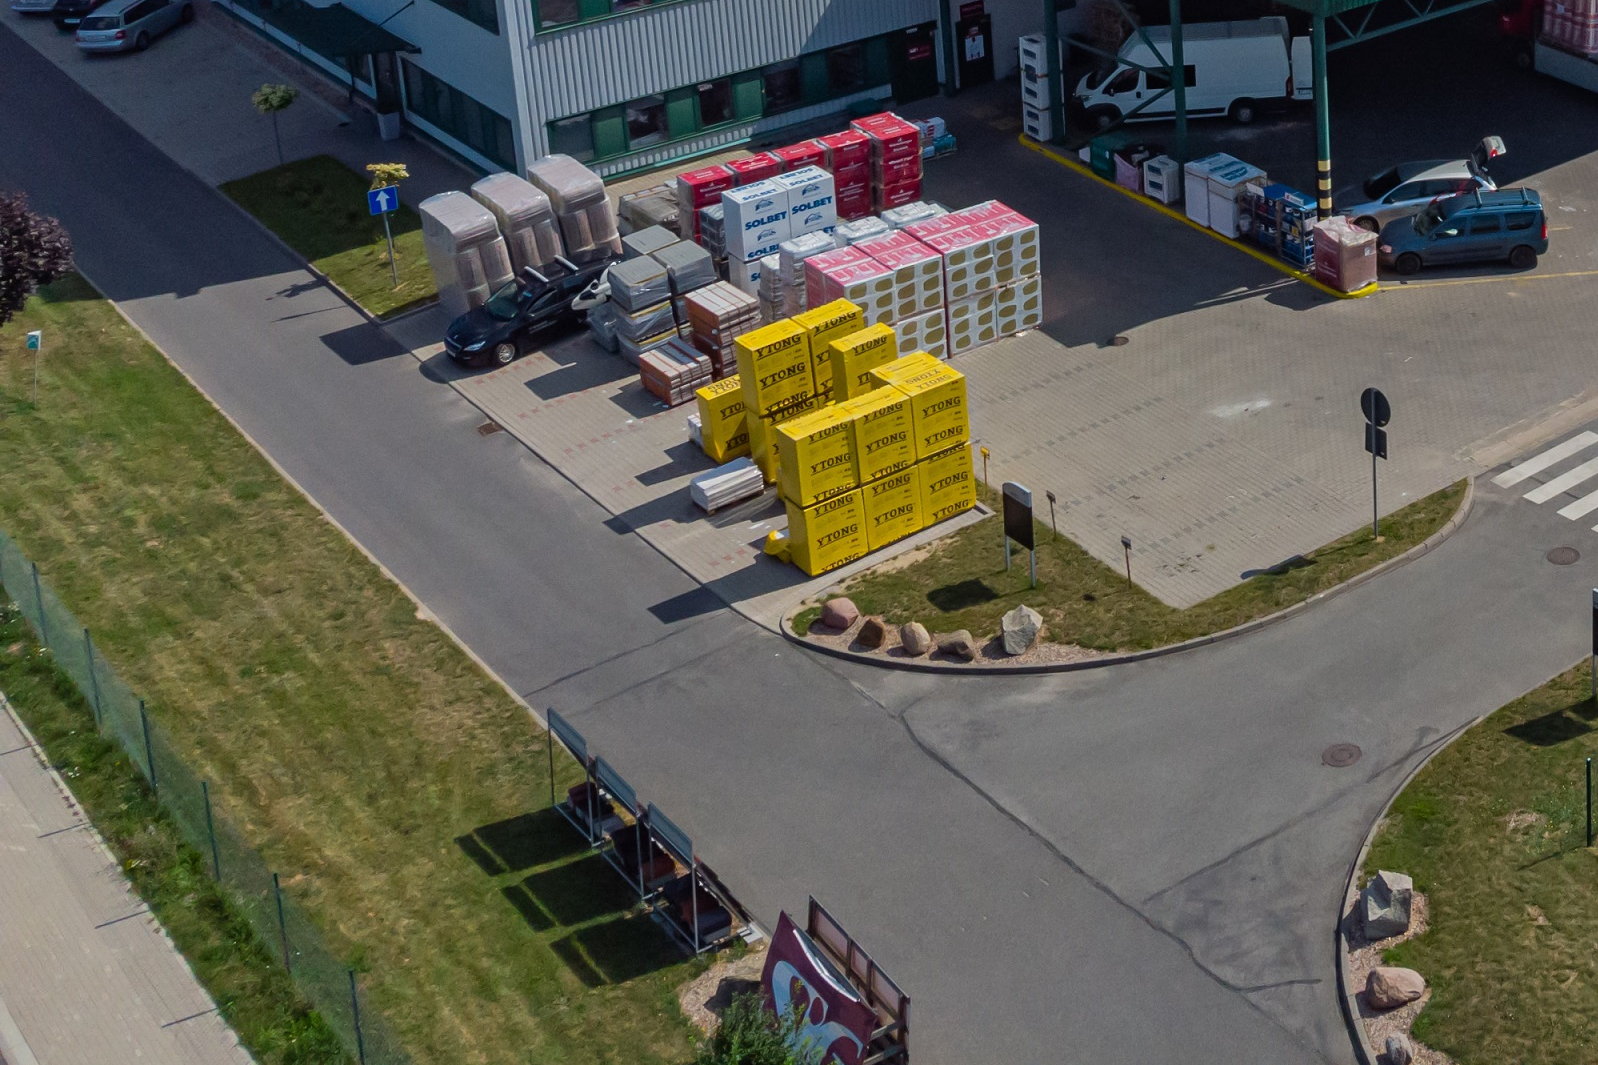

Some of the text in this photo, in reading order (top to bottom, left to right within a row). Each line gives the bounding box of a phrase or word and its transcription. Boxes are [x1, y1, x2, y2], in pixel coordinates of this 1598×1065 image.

[789, 173, 823, 187] SOLBET
[742, 188, 778, 201] SOLBET
[792, 195, 833, 215] SOLBET
[745, 211, 787, 231] SOLBET
[814, 311, 857, 335] YTONG
[756, 334, 801, 358] YTONG
[853, 335, 887, 353] YTONG
[760, 362, 806, 386] YTONG
[769, 398, 814, 423] YTONG
[863, 401, 903, 423] YTONG
[922, 395, 961, 416] YTONG
[808, 422, 849, 443] YTONG
[865, 431, 907, 454] YTONG
[924, 425, 963, 445] YTONG
[811, 452, 851, 473] YTONG
[870, 459, 909, 479] YTONG
[872, 472, 912, 495] YTONG
[929, 470, 969, 492] YTONG
[814, 491, 855, 517] YTONG
[874, 502, 914, 525] YTONG
[932, 498, 970, 520] YTONG
[816, 523, 859, 547] YTONG
[821, 552, 861, 573] YTONG
